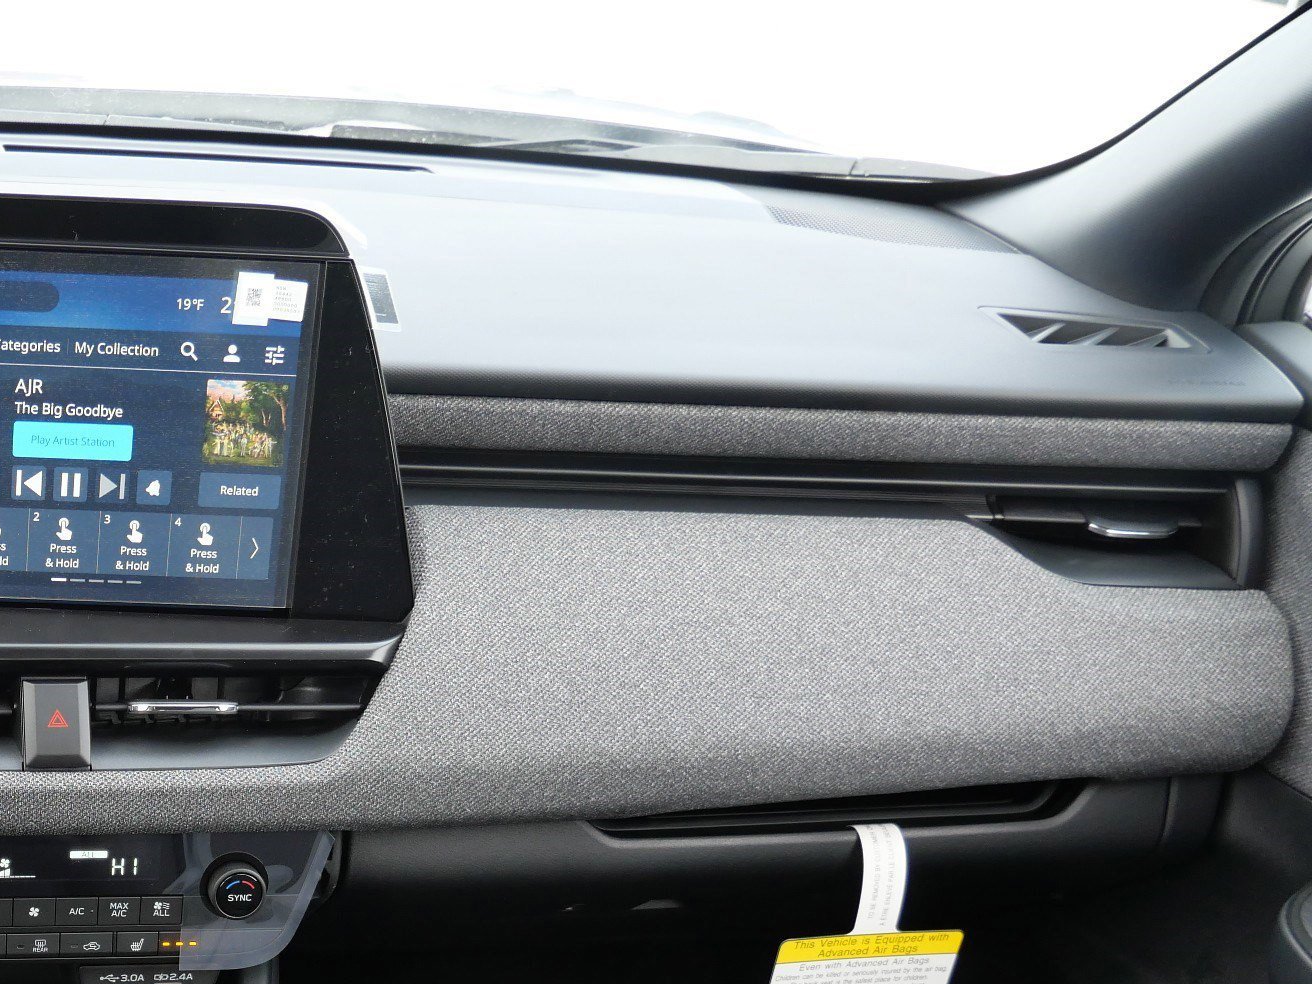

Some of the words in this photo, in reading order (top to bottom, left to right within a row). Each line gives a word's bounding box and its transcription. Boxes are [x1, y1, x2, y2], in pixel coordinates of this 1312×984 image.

[75, 342, 94, 356] My
[97, 343, 159, 356] Collection
[15, 379, 43, 396] AJR
[15, 402, 38, 414] The
[42, 403, 62, 418] Big
[66, 404, 123, 420] Goodbye
[31, 435, 50, 447] Play
[53, 436, 78, 445] Artist
[81, 437, 115, 447] Station
[220, 486, 258, 496] Related
[33, 512, 40, 521] 2
[104, 515, 110, 524] 3
[175, 517, 182, 527] 4
[50, 544, 76, 553] Press
[120, 546, 147, 556] Press
[190, 549, 217, 558] Press
[46, 558, 53, 567] &
[56, 558, 79, 568] Hold
[116, 561, 123, 570] &
[126, 561, 149, 571] Hold
[186, 563, 193, 572] &
[196, 563, 219, 573] Hold
[228, 894, 252, 902] SYNC
[110, 902, 129, 910] MAX
[820, 938, 855, 948] Vehicle
[862, 937, 870, 945] is
[875, 934, 923, 946] Equipped
[817, 947, 868, 958] Advanced
[872, 946, 887, 954] Air
[892, 945, 918, 955] Bags
[799, 964, 820, 972] Even
[846, 959, 888, 968] Advanced
[908, 957, 929, 965] Bags
